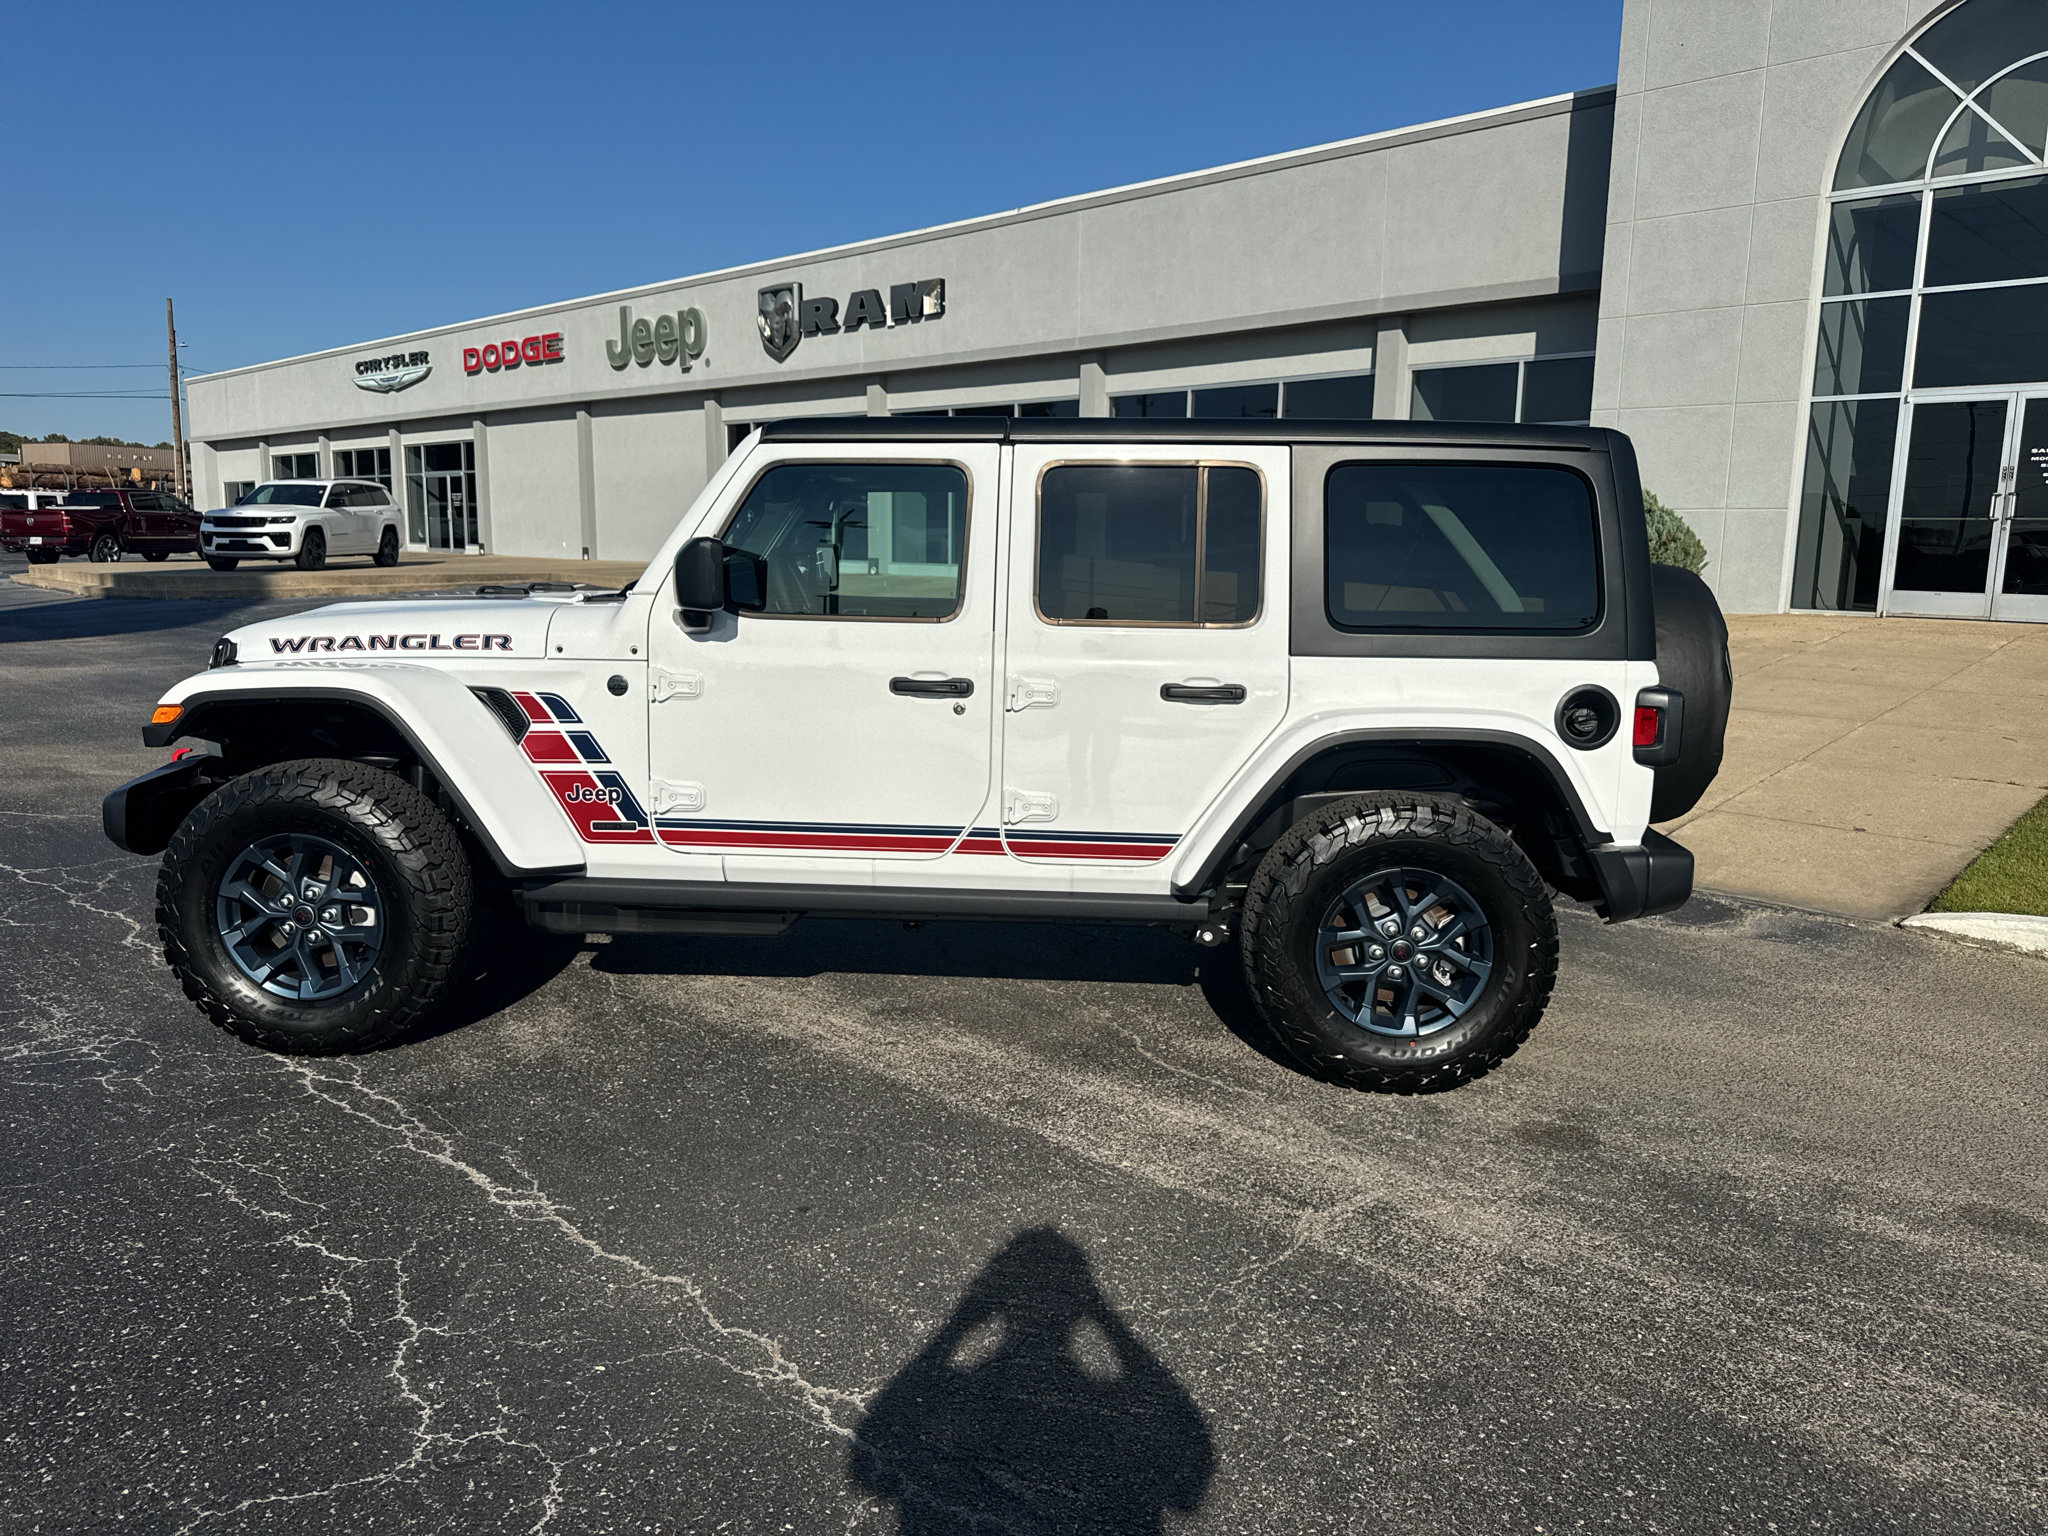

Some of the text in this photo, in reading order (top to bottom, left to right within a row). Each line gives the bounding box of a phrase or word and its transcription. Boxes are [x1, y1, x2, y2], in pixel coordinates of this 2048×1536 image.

[801, 279, 945, 339] RAM
[463, 333, 564, 376] DODGE
[606, 305, 707, 373] Jeep
[355, 350, 429, 375] CHRYSLER
[269, 634, 513, 655] WRANGLER
[566, 783, 622, 806] Jeep
